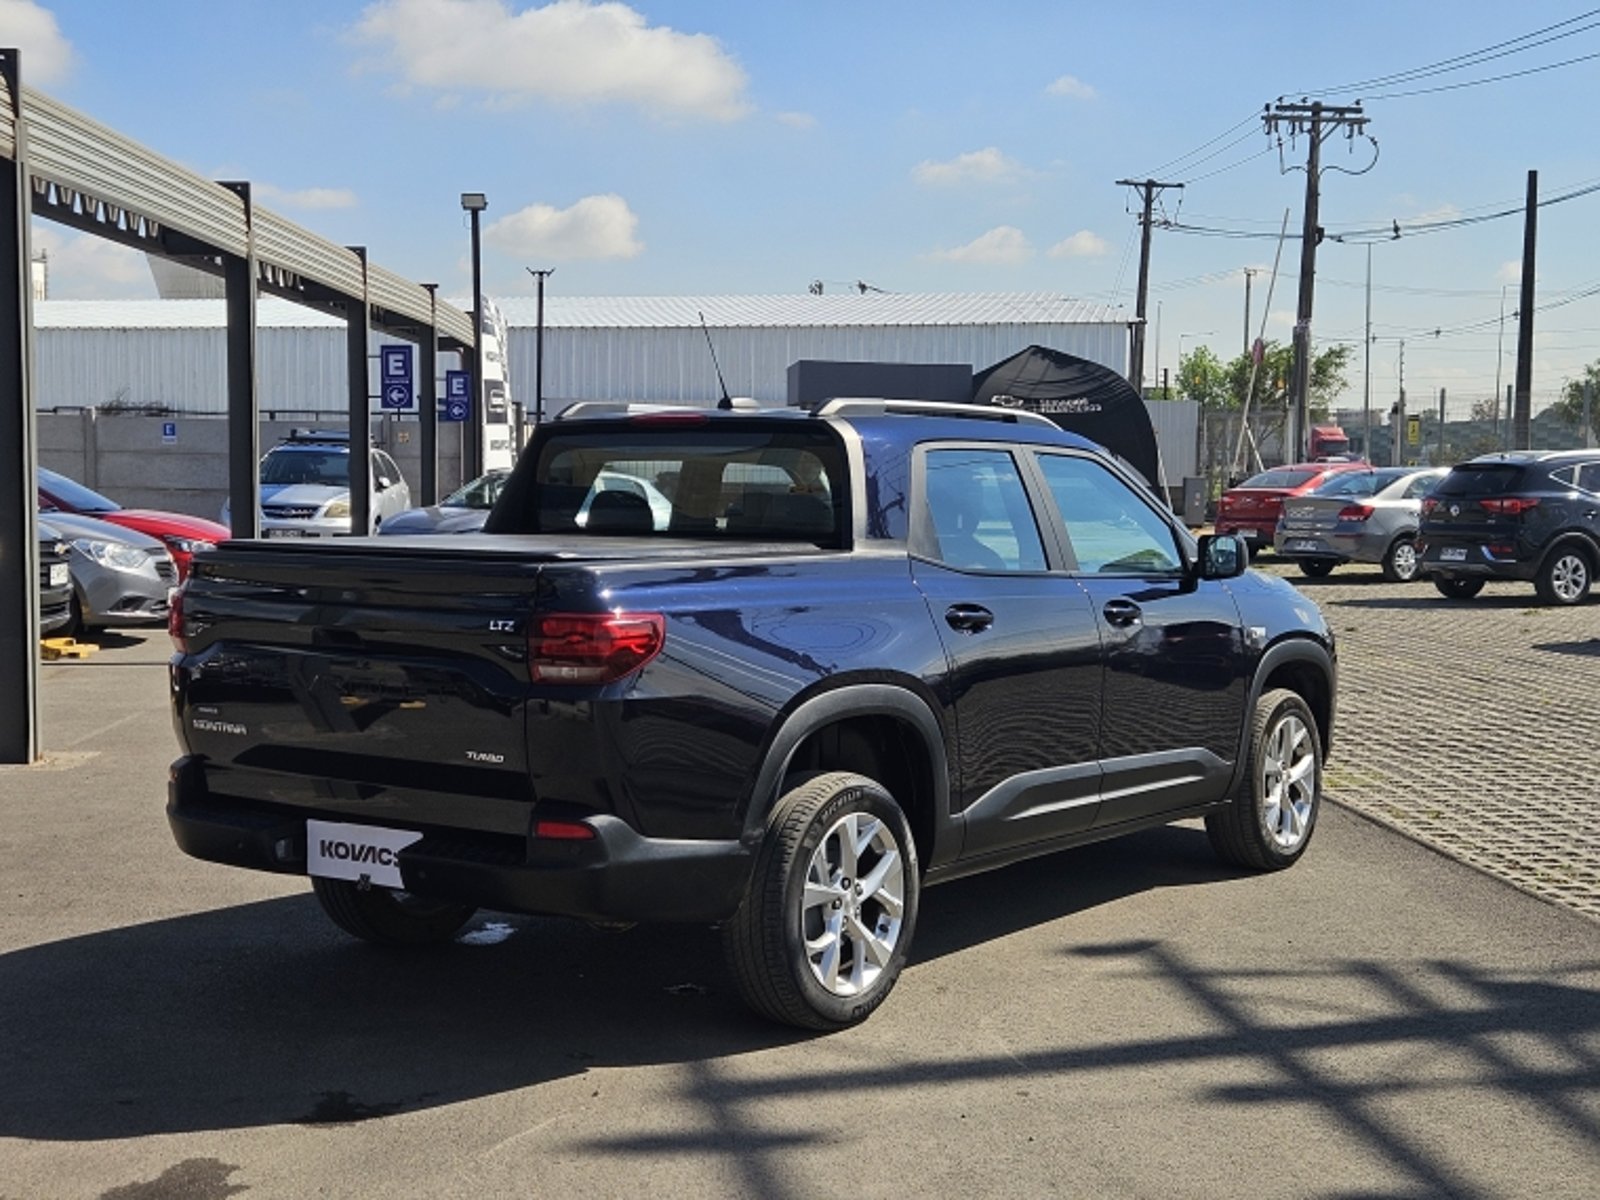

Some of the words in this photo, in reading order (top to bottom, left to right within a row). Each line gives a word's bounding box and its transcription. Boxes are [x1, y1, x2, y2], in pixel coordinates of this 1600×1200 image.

[388, 354, 405, 375] E
[452, 378, 464, 395] E
[490, 620, 514, 632] LTZ
